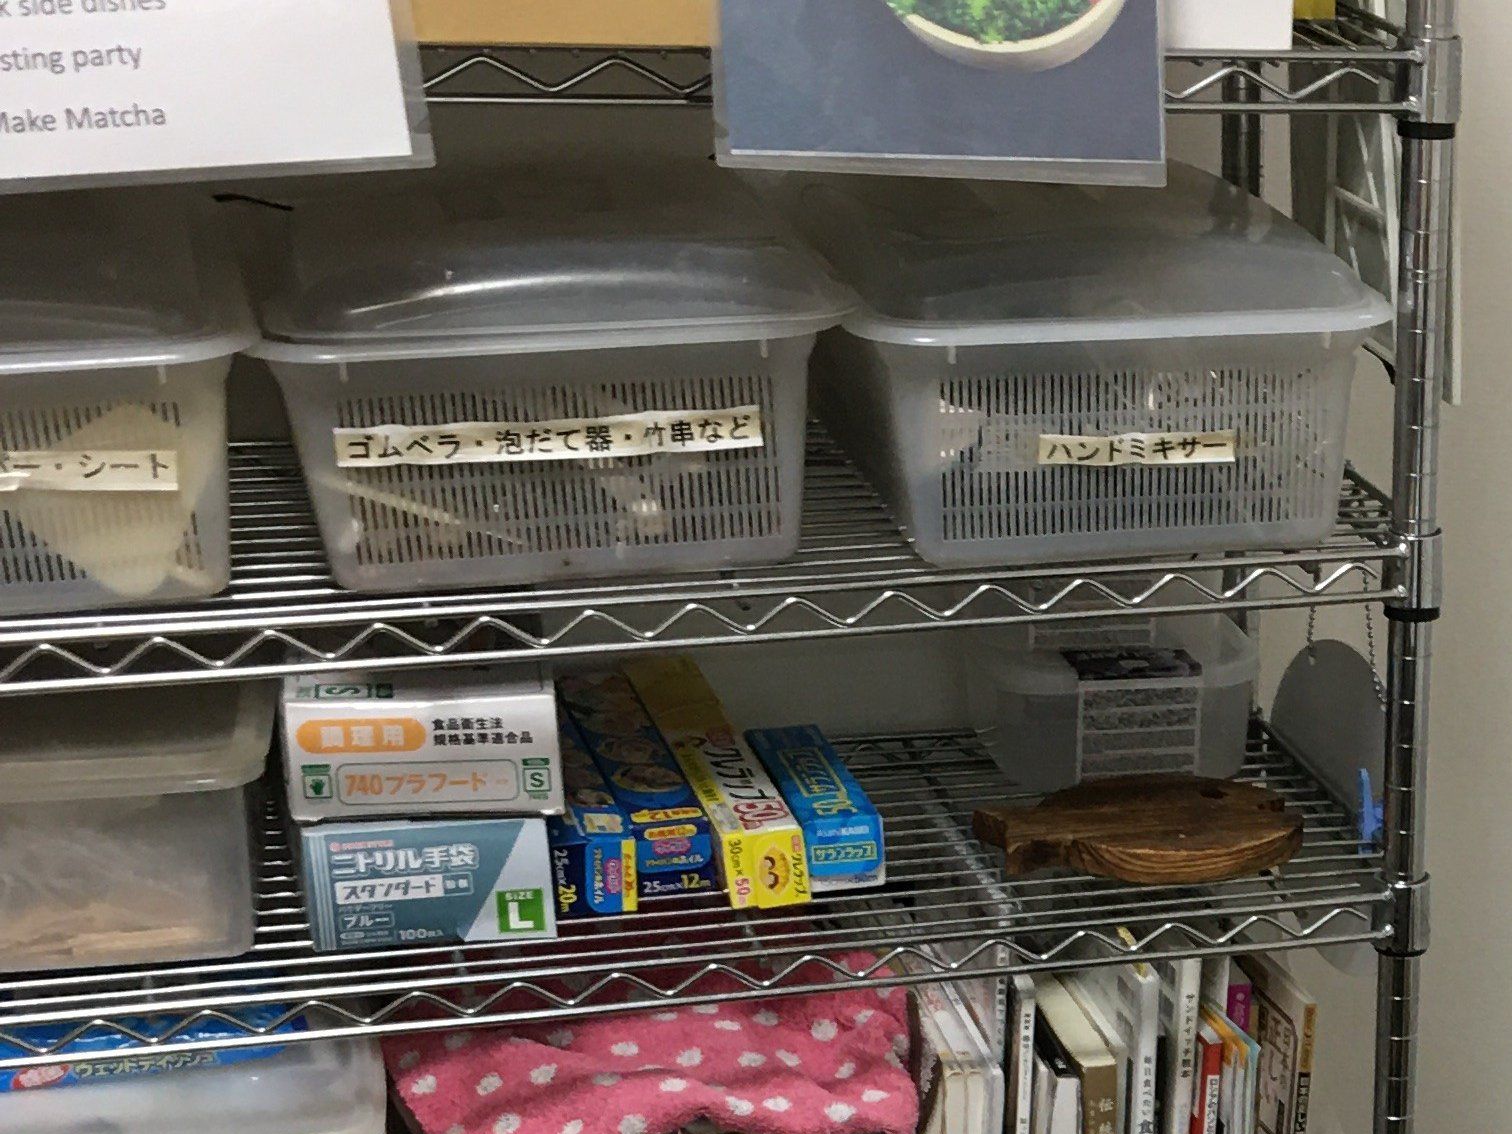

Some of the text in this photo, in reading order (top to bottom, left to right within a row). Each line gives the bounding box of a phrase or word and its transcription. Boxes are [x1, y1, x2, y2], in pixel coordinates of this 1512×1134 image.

[0, 45, 142, 74] sting party
[65, 103, 166, 129] Matcha
[1047, 436, 1227, 462] ハンドミキサー
[530, 772, 545, 788] S
[331, 844, 479, 878] ニトリル手袋
[342, 877, 438, 901] スタンダード
[504, 891, 535, 901] SIZE
[343, 914, 391, 929] ブルー
[507, 901, 535, 930] L
